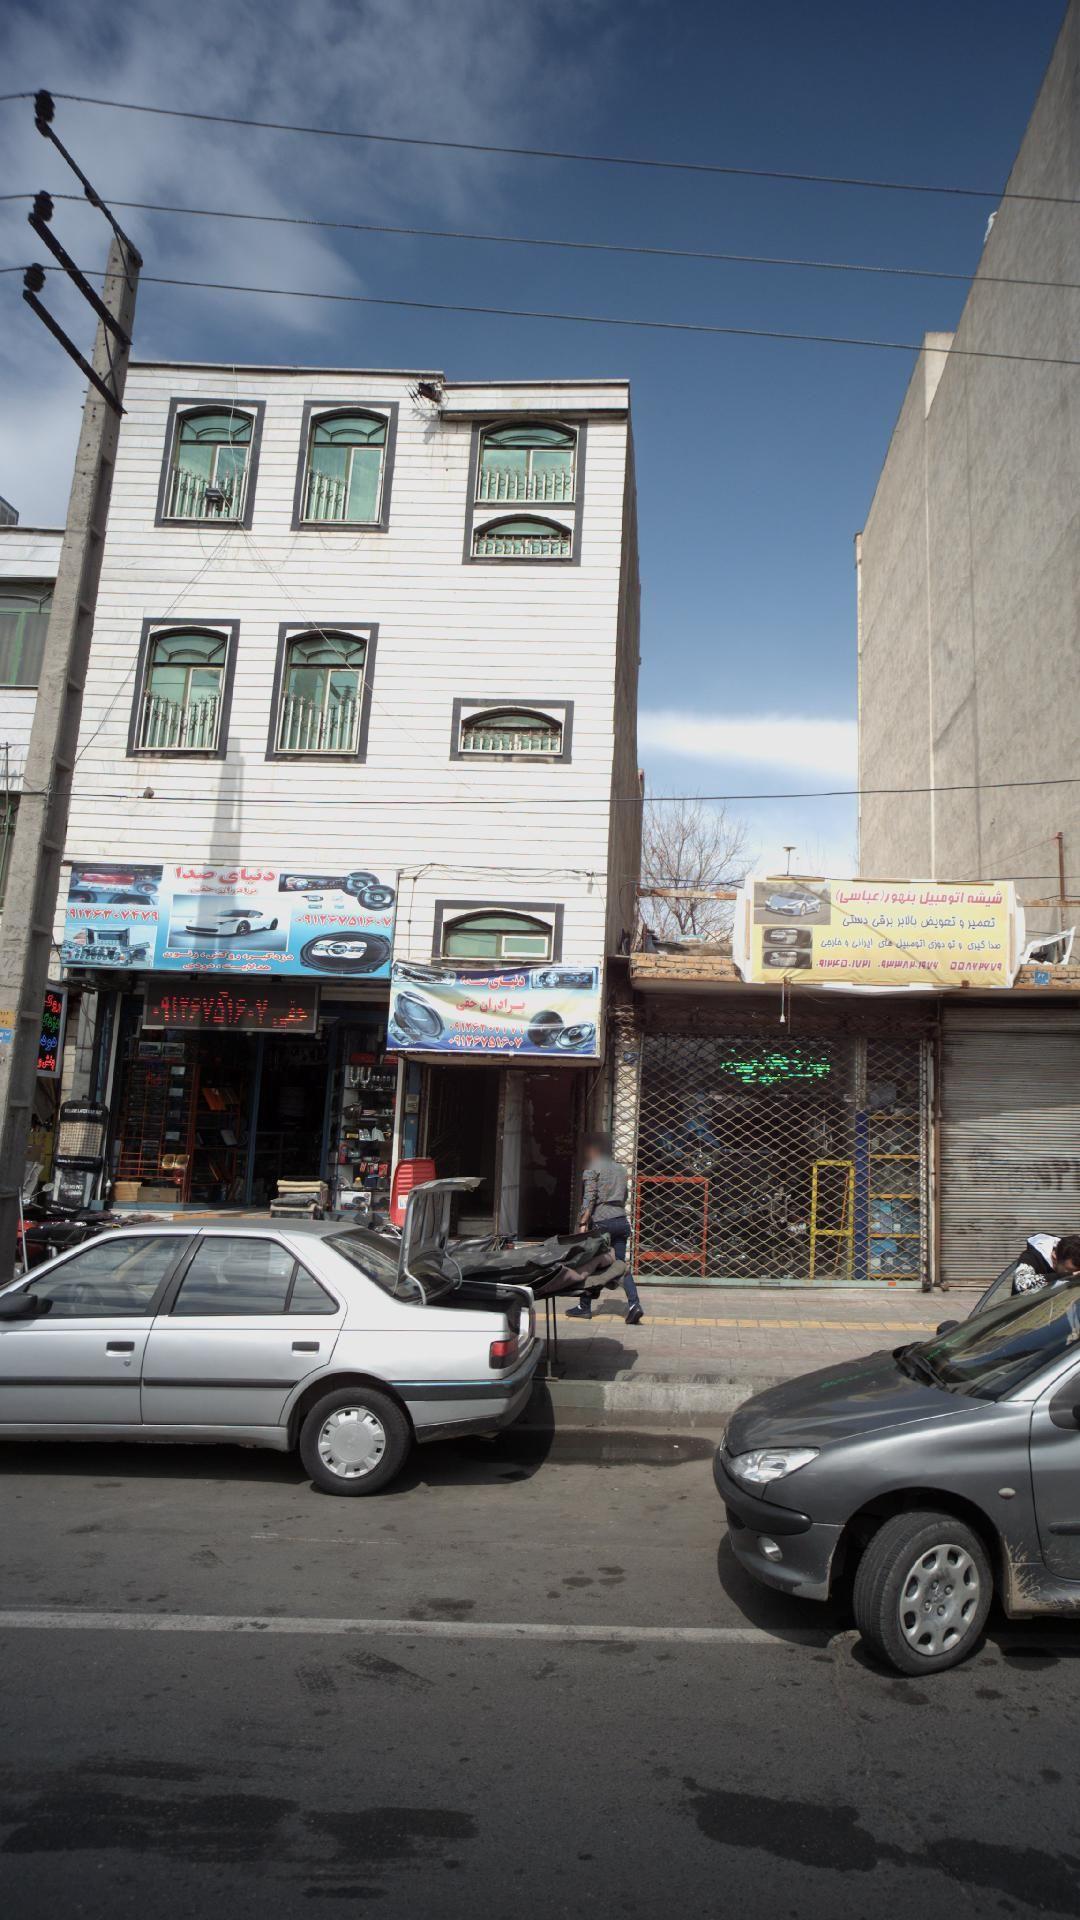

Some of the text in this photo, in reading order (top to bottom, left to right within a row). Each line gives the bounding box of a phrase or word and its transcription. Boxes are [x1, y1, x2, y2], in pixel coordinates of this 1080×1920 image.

[175, 866, 275, 884] دنیای صدا
[919, 891, 963, 906] اتومبیل
[967, 890, 1003, 907] شیشه
[843, 914, 996, 929] تعمیر و تعویض بالابر برقی دستی
[820, 939, 842, 948] خارجی
[852, 938, 873, 949] ایرانی
[988, 940, 1001, 949] صدا
[488, 975, 526, 989] دنیای
[456, 997, 525, 1015] برادران حقی
